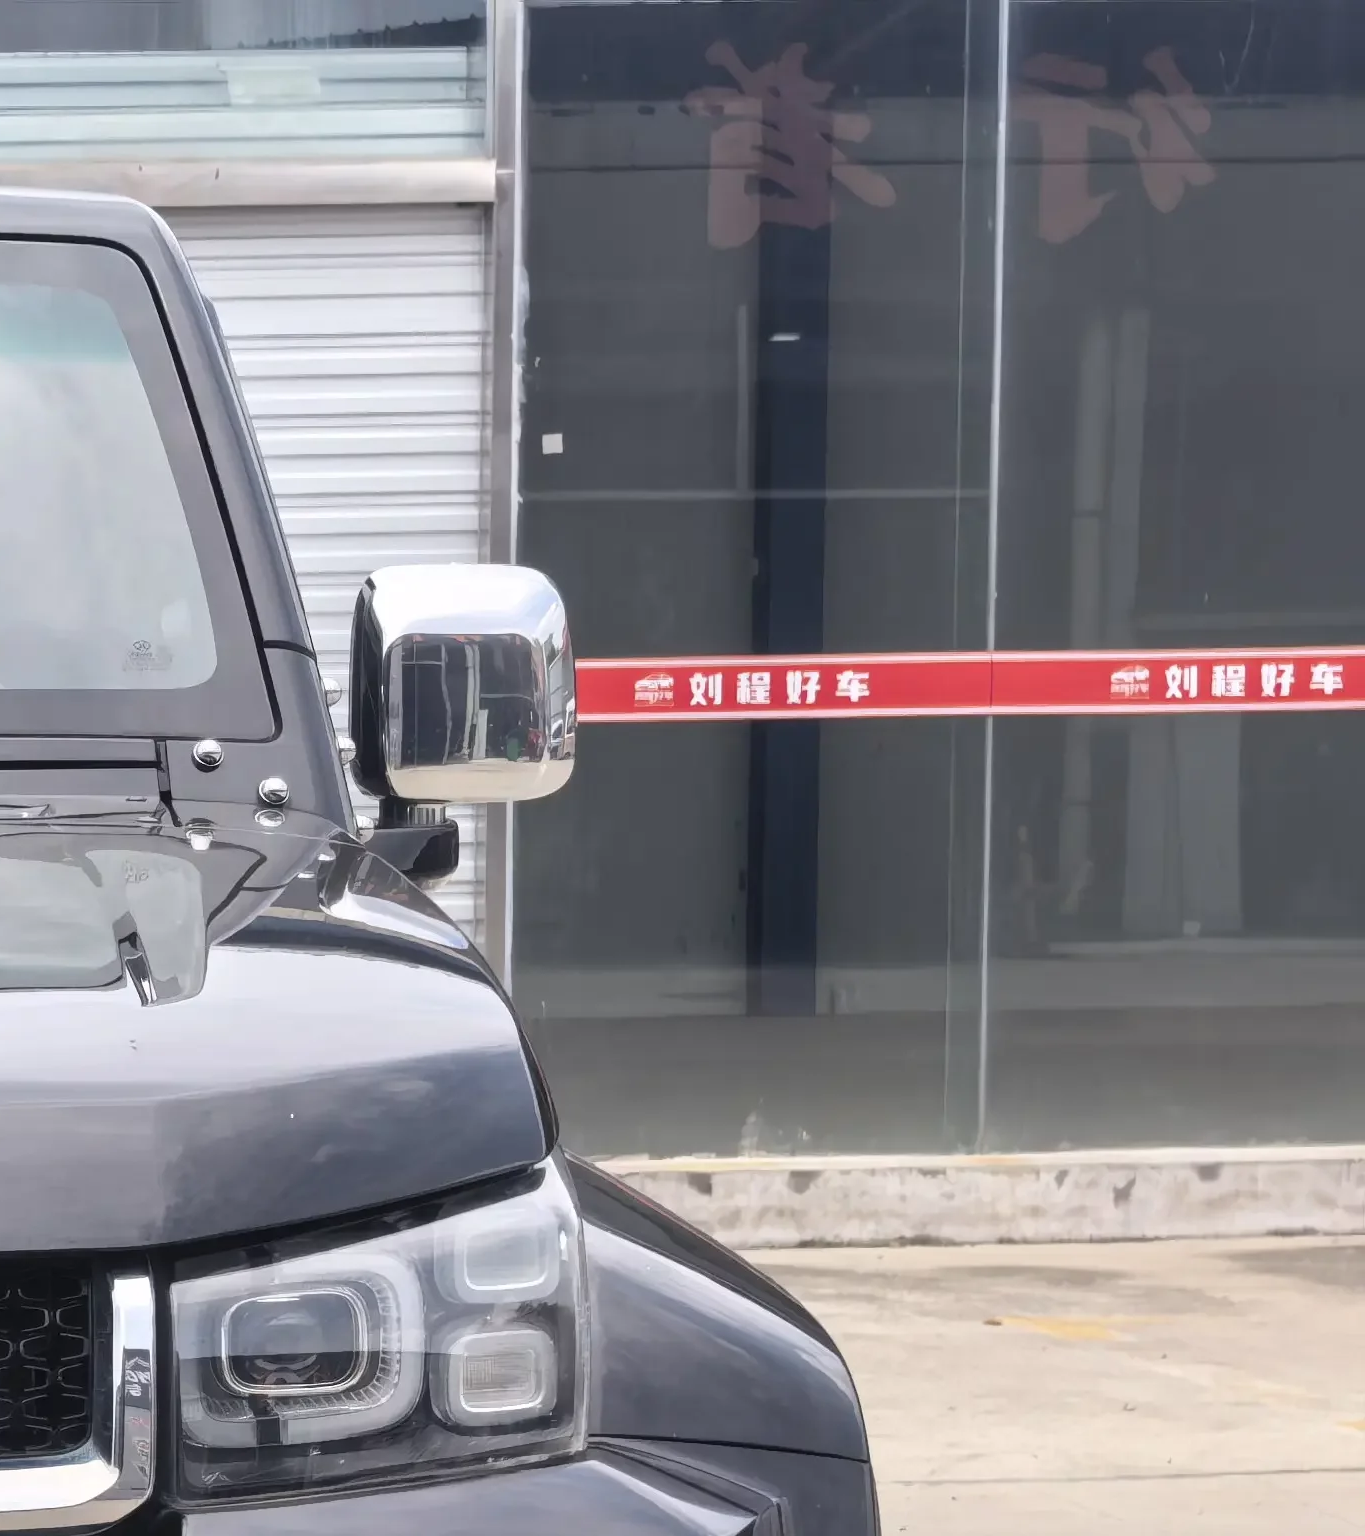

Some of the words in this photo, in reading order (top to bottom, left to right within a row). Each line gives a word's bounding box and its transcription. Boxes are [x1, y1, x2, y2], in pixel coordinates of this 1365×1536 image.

[689, 670, 870, 705] 刘程好车
[1165, 662, 1344, 698] 刘程好车
